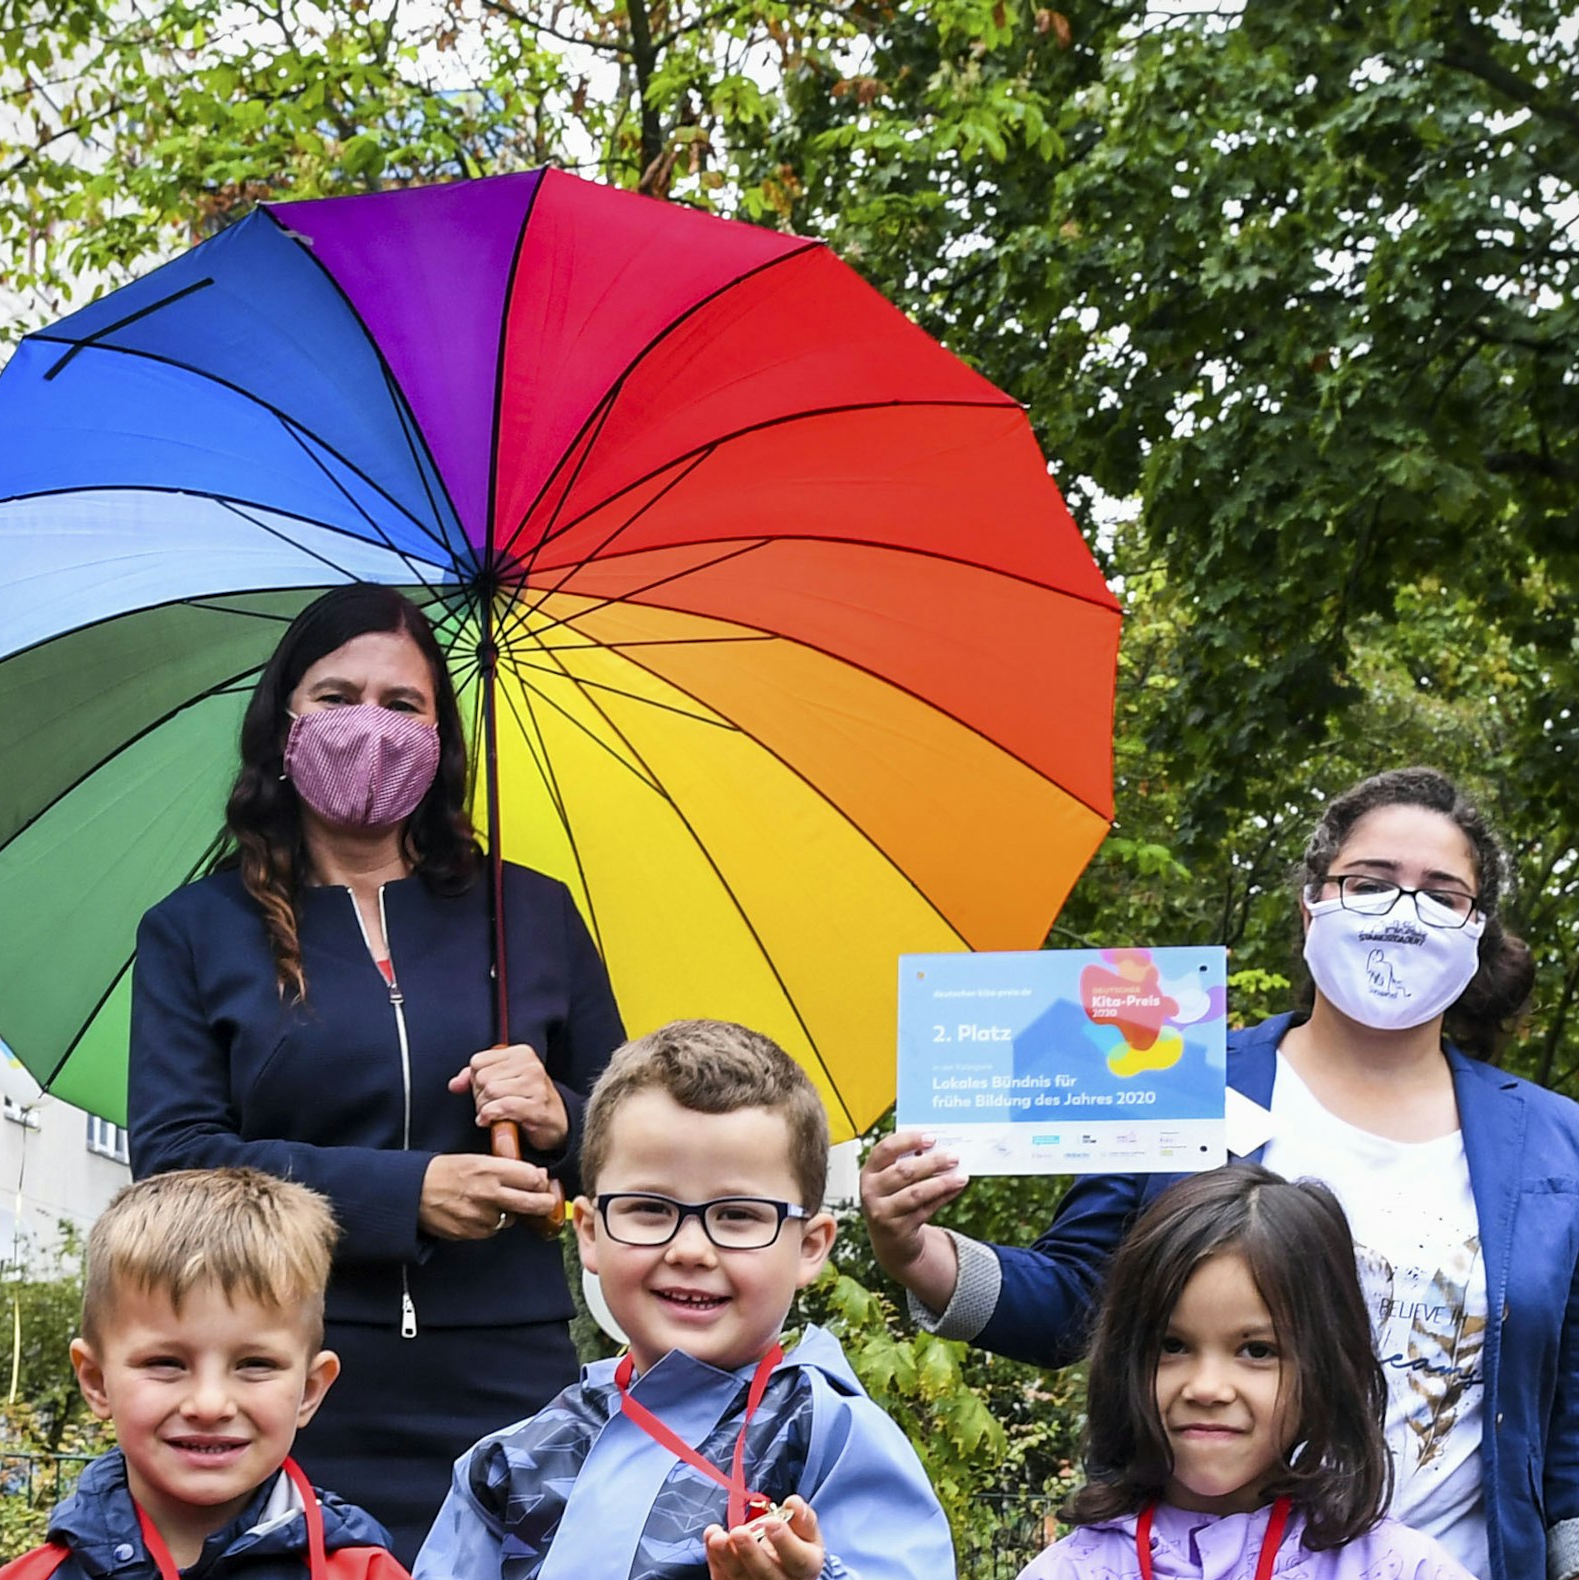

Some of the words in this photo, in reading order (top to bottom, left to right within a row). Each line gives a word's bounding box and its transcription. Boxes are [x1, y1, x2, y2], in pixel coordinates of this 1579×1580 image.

[1092, 995, 1161, 1007] Kita-Preis
[1092, 1008, 1118, 1018] 2020
[932, 1024, 952, 1042] 2.
[957, 1023, 1012, 1042] Platz
[932, 1077, 988, 1090] Lokales
[991, 1074, 1051, 1089] Bündnis
[1055, 1073, 1077, 1087] für
[932, 1095, 971, 1108] frühe
[975, 1093, 1031, 1110] Bildung
[1034, 1092, 1060, 1106] des
[1063, 1092, 1113, 1106] Jahres
[1115, 1091, 1157, 1105] 2020
[1380, 1298, 1447, 1324] BELIEVE
